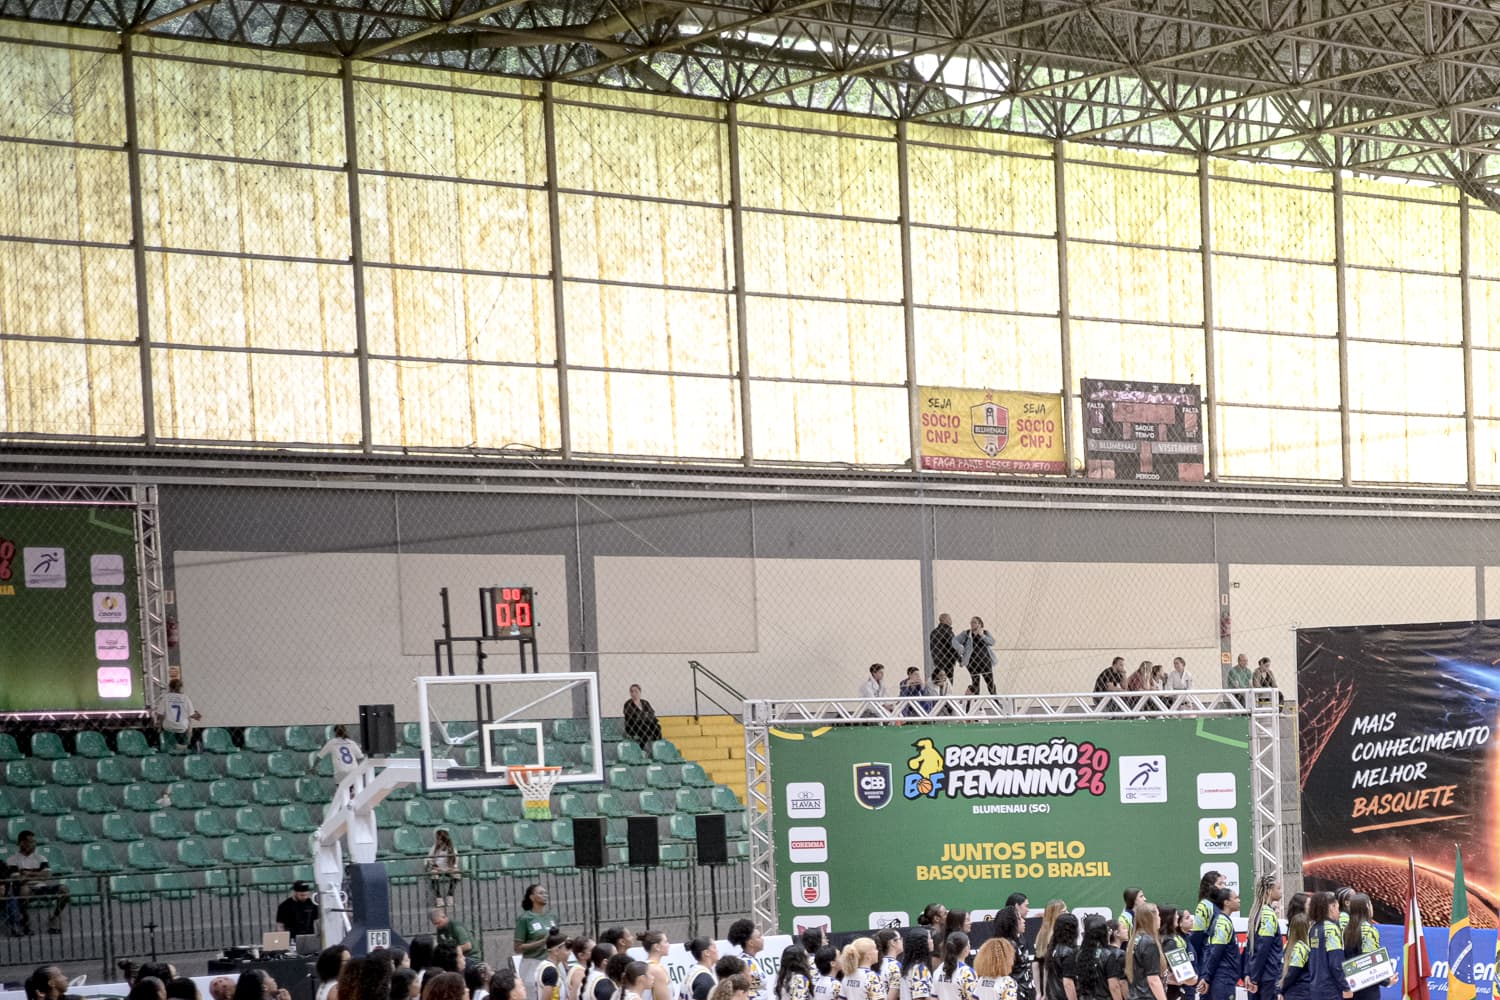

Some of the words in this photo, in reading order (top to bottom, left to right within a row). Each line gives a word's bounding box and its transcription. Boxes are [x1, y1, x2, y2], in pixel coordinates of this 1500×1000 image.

[928, 397, 952, 409] SEJA
[1023, 403, 1046, 414] SEJA
[922, 411, 961, 428] SÓCIO
[1017, 416, 1055, 433] SÓCIO
[926, 429, 959, 444] CNPJ
[1020, 434, 1053, 449] CNPJ
[171, 705, 181, 722] 7
[1351, 712, 1397, 736] MAIS
[1351, 726, 1490, 762] CONHECIMENTO
[339, 746, 351, 764] 8
[945, 737, 1078, 767] BRASILEIRÃO
[1078, 742, 1110, 770] 20
[949, 768, 1078, 797] FEMININO
[1075, 772, 1106, 796] 26
[1352, 762, 1428, 789] MELHOR
[791, 801, 821, 809] HAVAN
[972, 804, 1027, 814] BLUMENAU
[1028, 803, 1050, 814] (SC)
[1352, 784, 1458, 818] BASQUETE
[941, 842, 1026, 862] JUNTOS
[1030, 840, 1085, 859] PELO
[916, 863, 1011, 882] BASQUETE
[1015, 863, 1044, 879] DO
[1048, 861, 1111, 878] BRASIL
[803, 876, 817, 888] FCB
